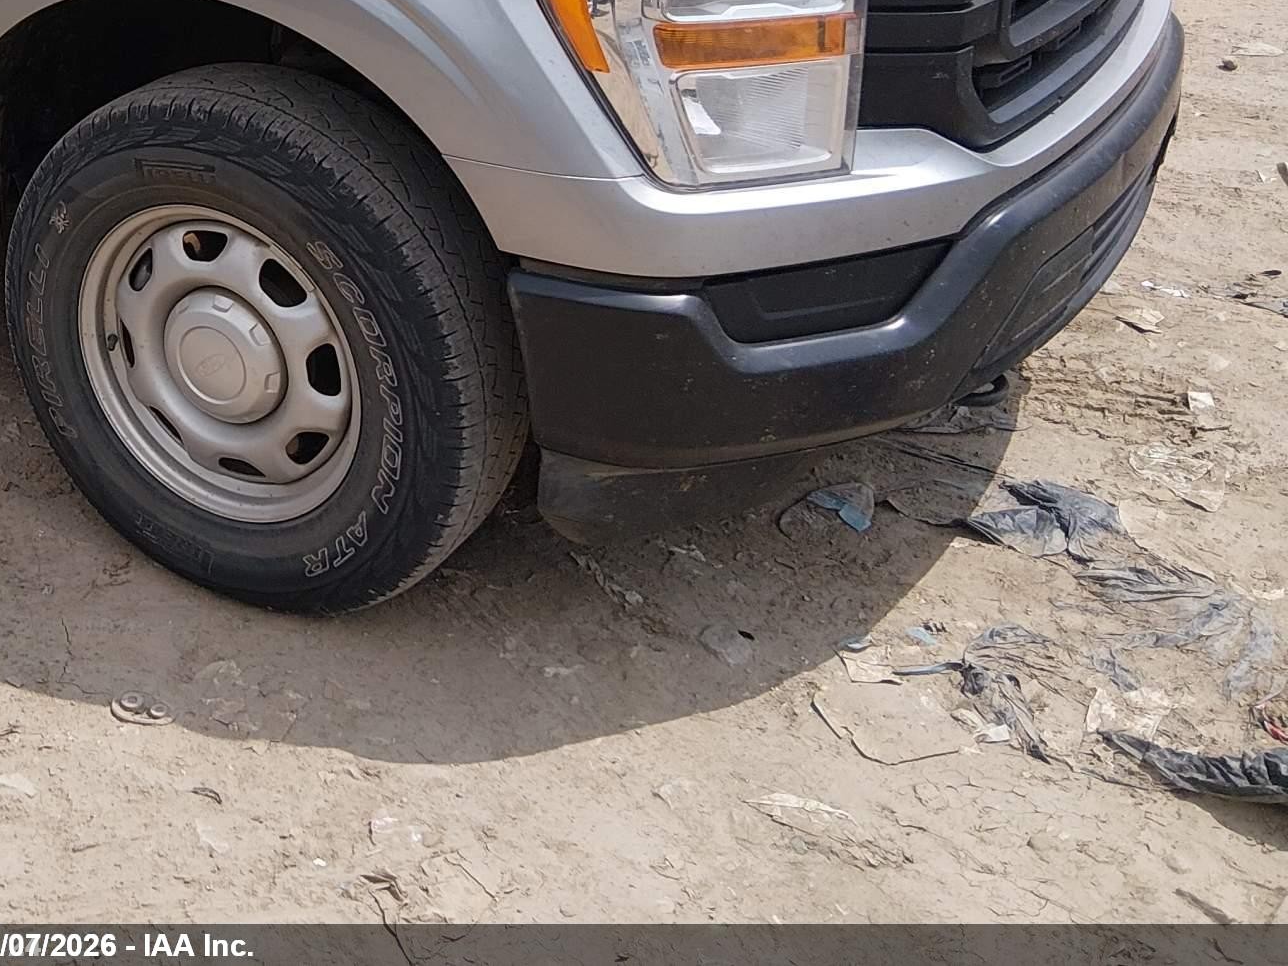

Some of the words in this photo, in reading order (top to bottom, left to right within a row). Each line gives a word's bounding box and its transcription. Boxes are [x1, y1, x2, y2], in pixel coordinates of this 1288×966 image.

[25, 242, 79, 440] PIRELLI
[306, 240, 403, 515] SCORPION
[302, 510, 368, 577] ATR
